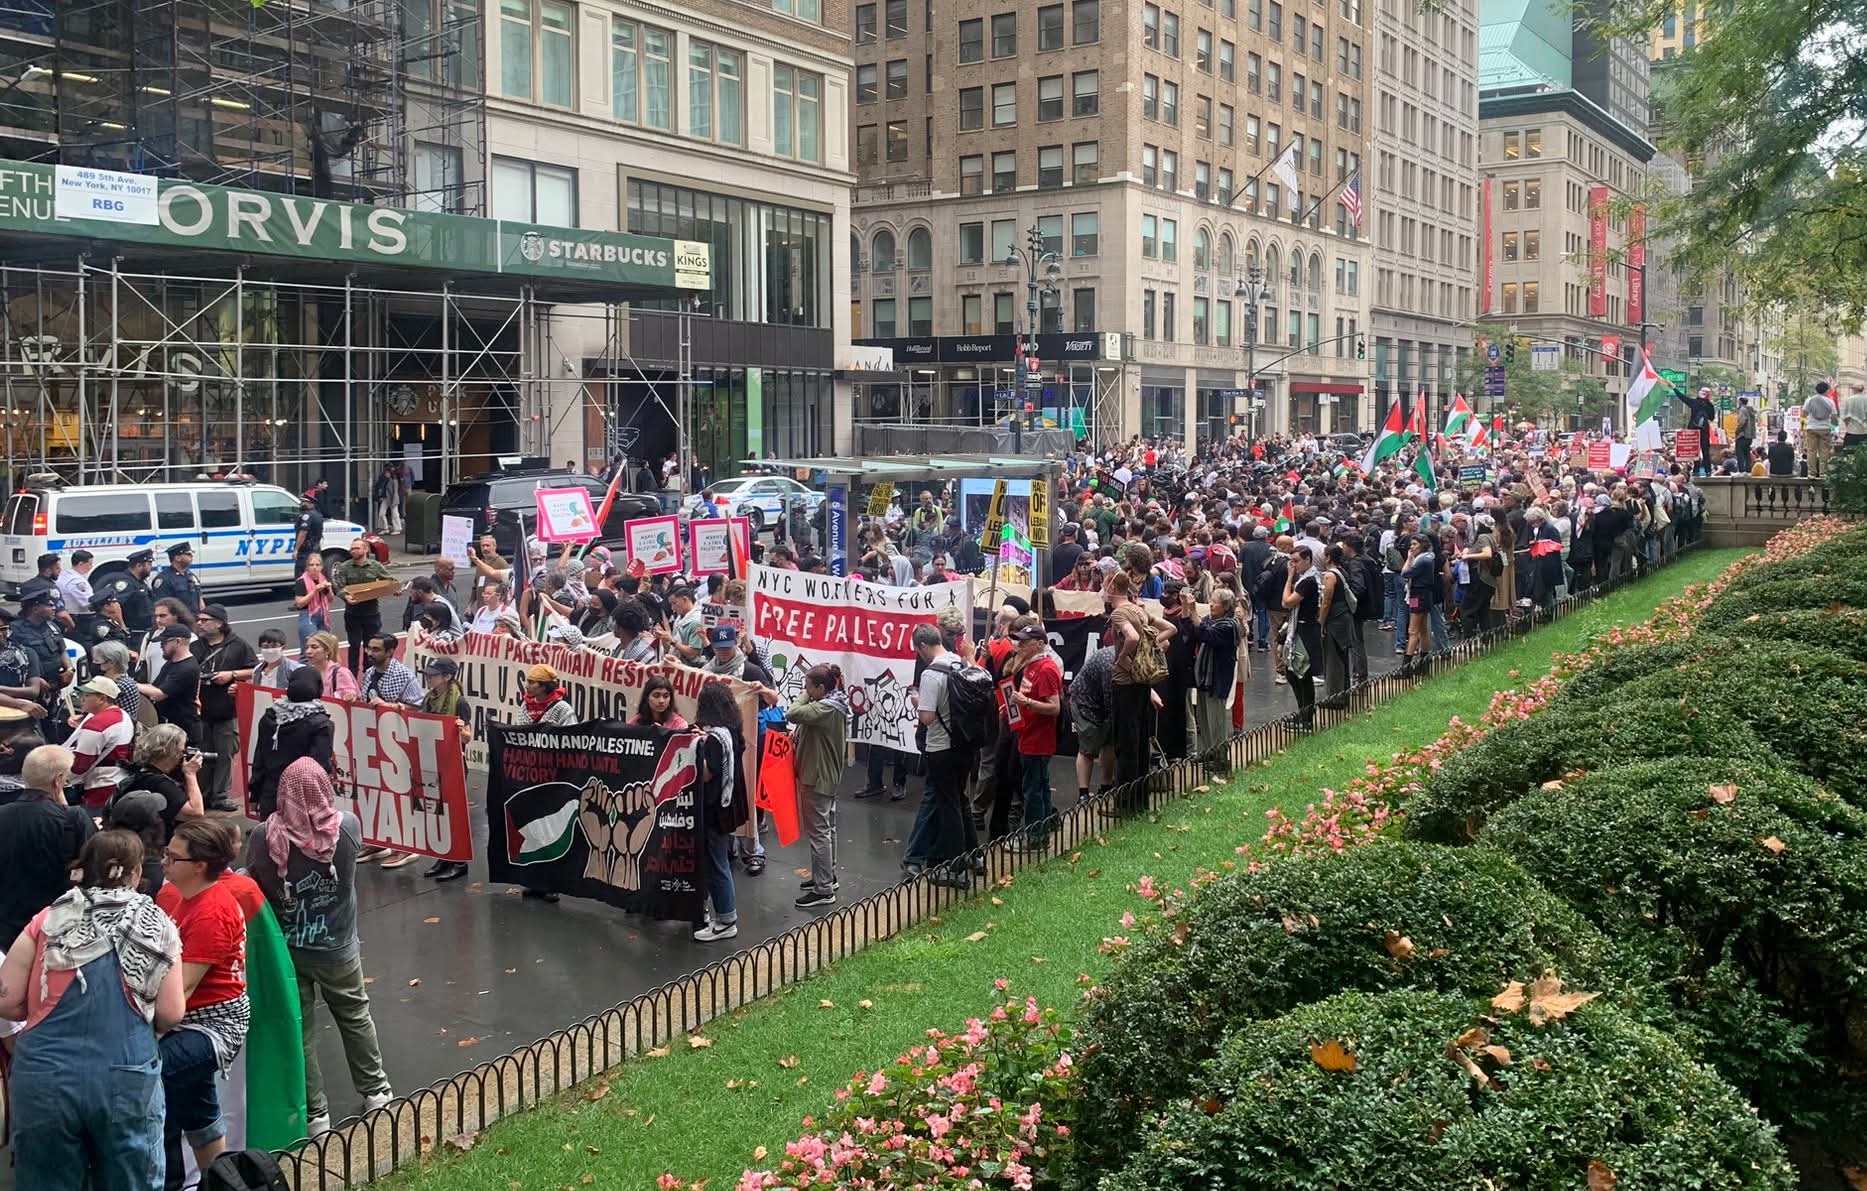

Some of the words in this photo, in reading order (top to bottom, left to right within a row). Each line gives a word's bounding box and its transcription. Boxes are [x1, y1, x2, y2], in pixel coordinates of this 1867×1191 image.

[62, 177, 82, 187] New
[85, 180, 109, 190] York,
[110, 184, 124, 192] NY
[126, 185, 152, 195] 10017
[77, 170, 95, 180] 489
[99, 172, 115, 182] 5th
[117, 175, 137, 185] Ave.
[92, 198, 125, 211] RBG
[158, 184, 407, 255] ORVIS
[549, 240, 668, 268] STARBUCKS
[677, 255, 707, 268] KINGS
[956, 343, 971, 352] Robb
[971, 344, 992, 353] Report
[63, 536, 137, 548] AUXILIARY
[757, 570, 792, 594] NYC
[805, 578, 887, 606] WORKERS
[897, 591, 935, 609] FOR
[760, 601, 816, 639] FREE
[466, 631, 501, 659] WITH
[504, 637, 596, 679] PALESTINIAN
[503, 731, 559, 749] LEBANON
[561, 735, 589, 750] AND
[588, 735, 655, 756] PALESTINE:
[503, 748, 537, 766] HAND
[556, 753, 589, 770] HAND
[503, 763, 558, 782] VICTORY
